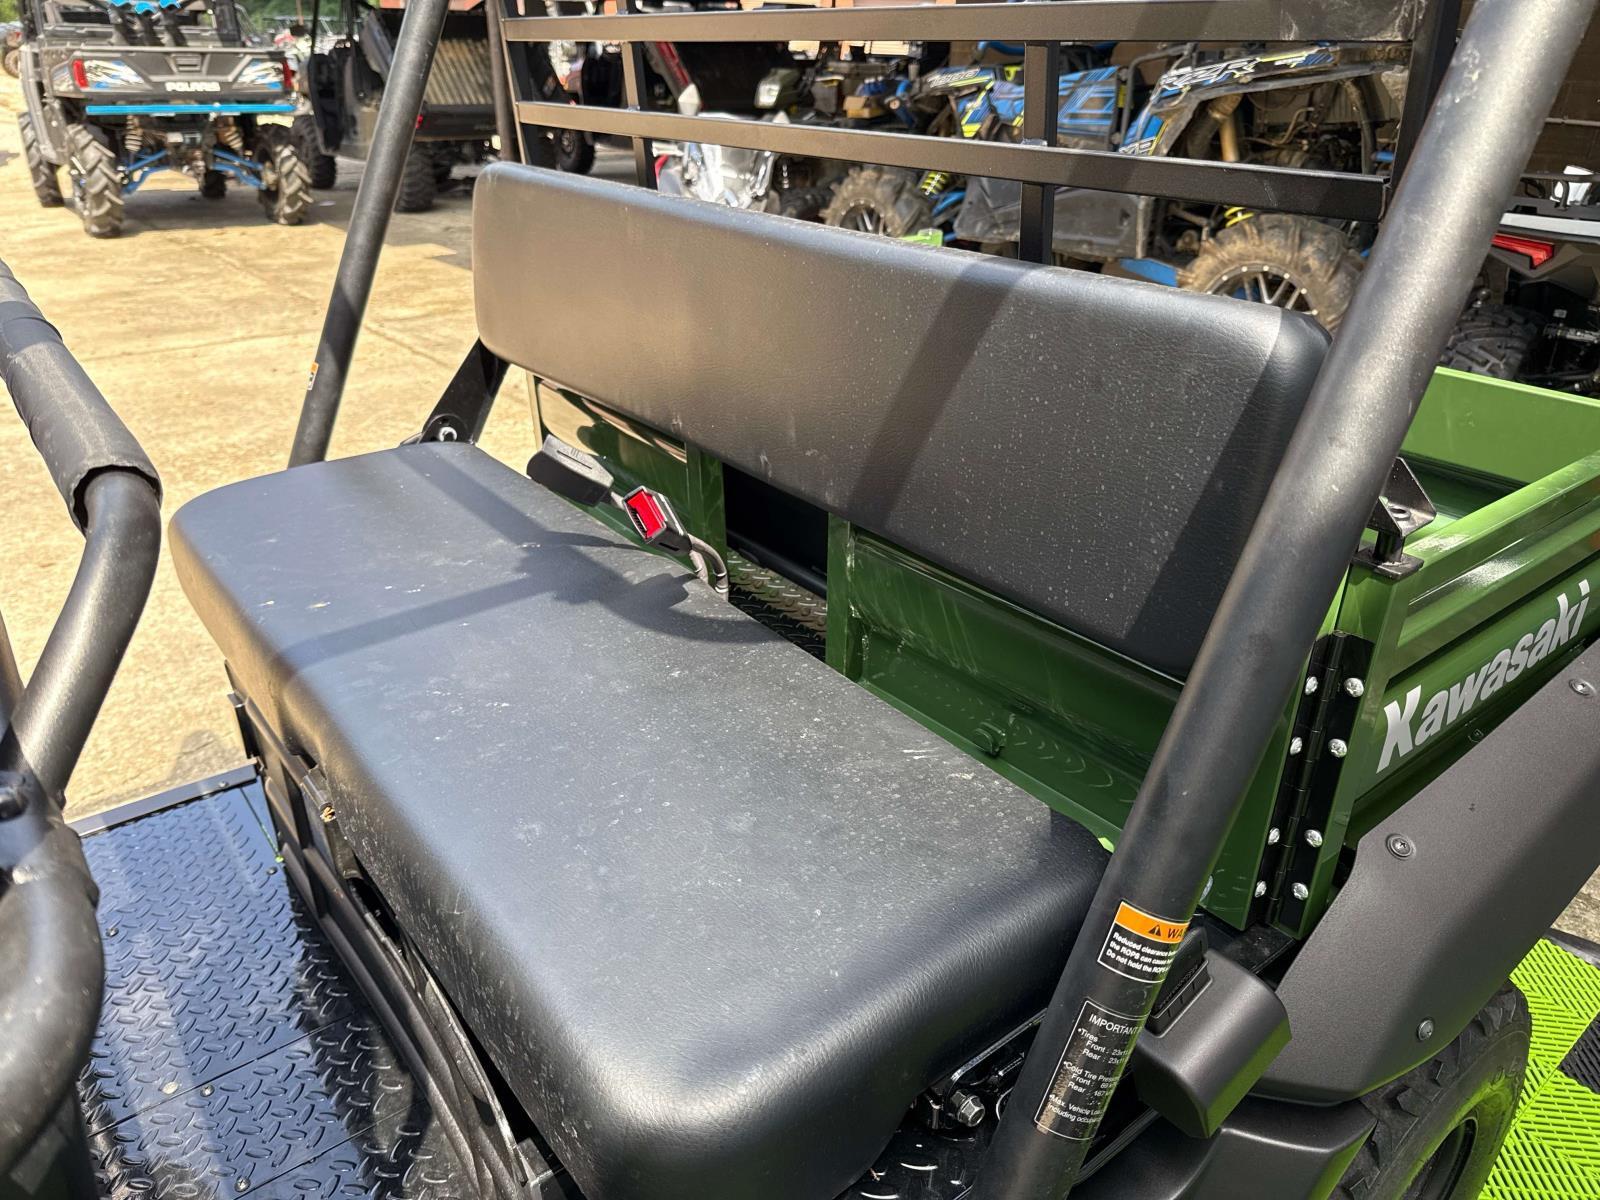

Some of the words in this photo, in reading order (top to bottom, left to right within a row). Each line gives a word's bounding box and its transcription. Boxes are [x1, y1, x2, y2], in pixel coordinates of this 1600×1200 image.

[1376, 579, 1590, 774] Kawasaki
[1109, 940, 1120, 951] the
[1113, 932, 1142, 951] Reduced
[1141, 945, 1168, 957] clearance
[1106, 949, 1116, 959] Do
[1116, 954, 1128, 965] not
[1128, 959, 1143, 970] hold
[1143, 963, 1152, 973] the
[1089, 1013, 1141, 1035] IMPORTANT
[1086, 1040, 1106, 1053] Front
[1082, 1048, 1101, 1061] Rear
[1071, 1073, 1091, 1086] Front
[1083, 1070, 1098, 1081] Tire
[1068, 1081, 1086, 1094] Rear
[1068, 1103, 1091, 1116] Vehicle
